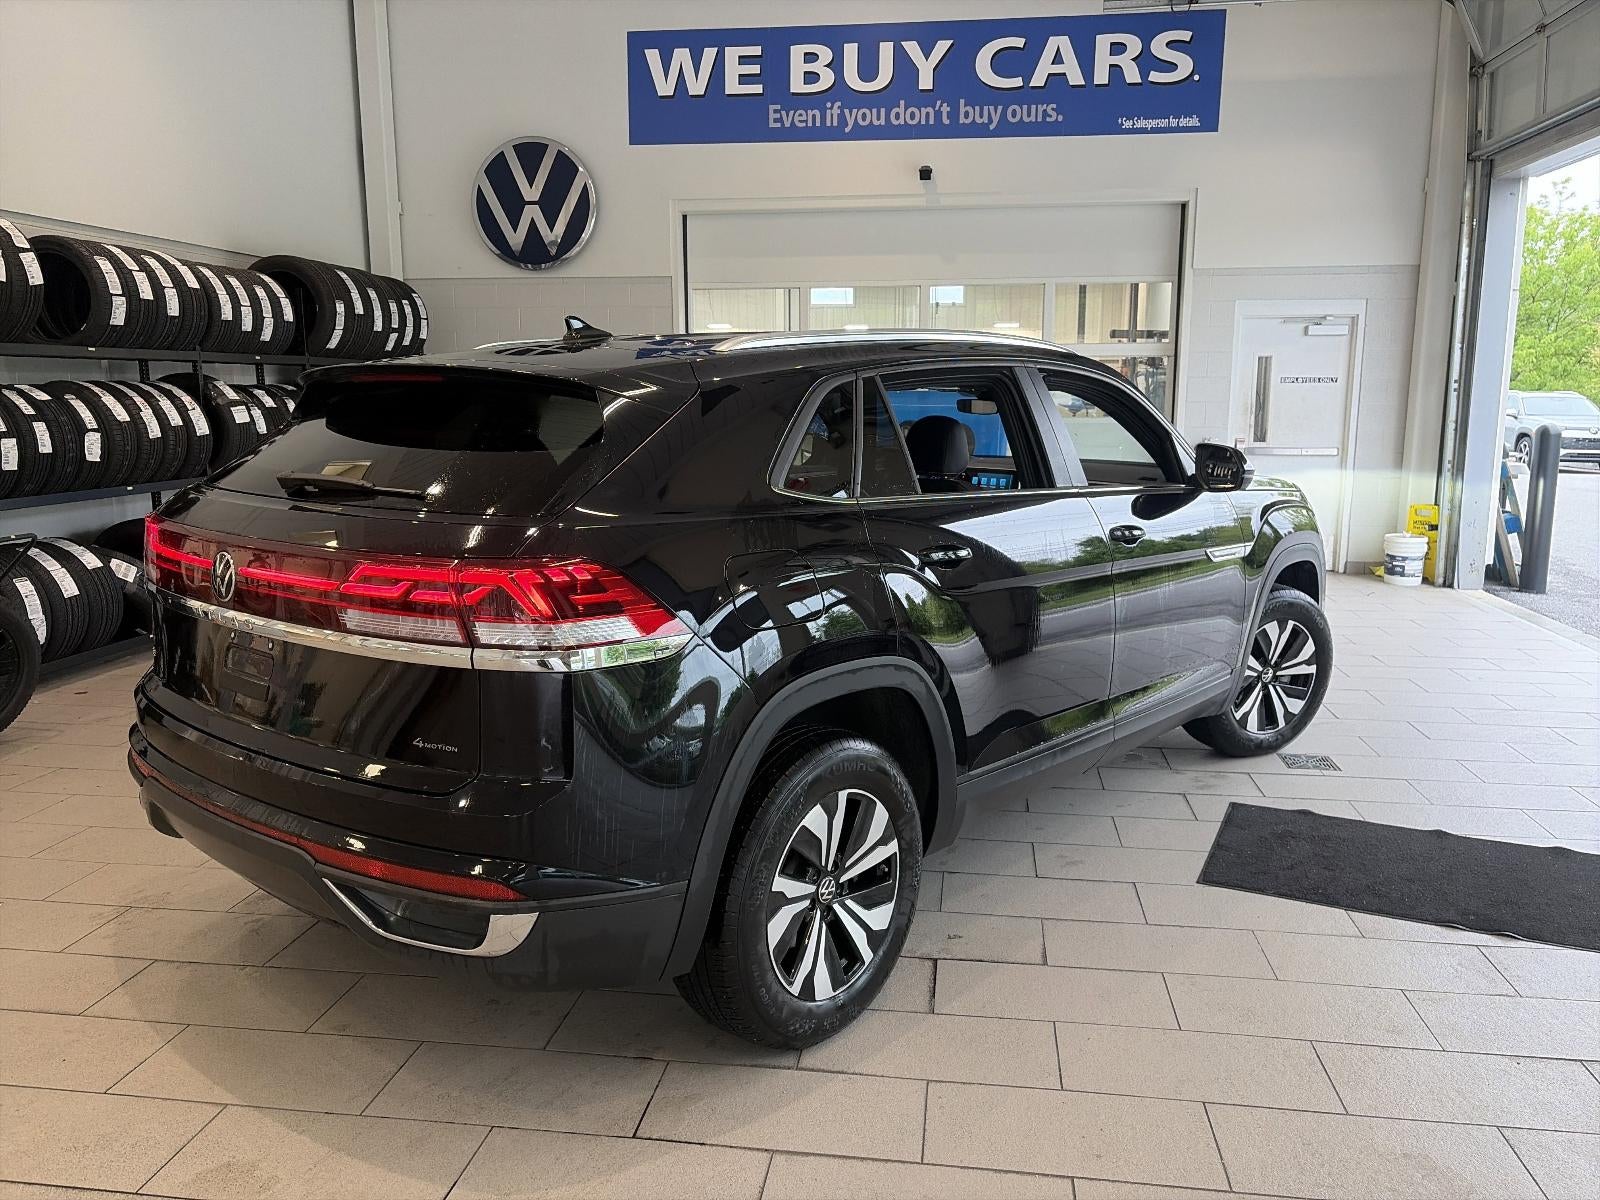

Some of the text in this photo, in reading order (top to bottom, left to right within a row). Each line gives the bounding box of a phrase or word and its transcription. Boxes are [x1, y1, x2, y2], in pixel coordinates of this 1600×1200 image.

[644, 29, 1200, 98] WE BUY CARS.
[768, 98, 1064, 133] Even if you don't buy ours.
[1133, 116, 1169, 131] Salesperson
[1169, 115, 1178, 127] for
[412, 737, 458, 753] 4MOTION
